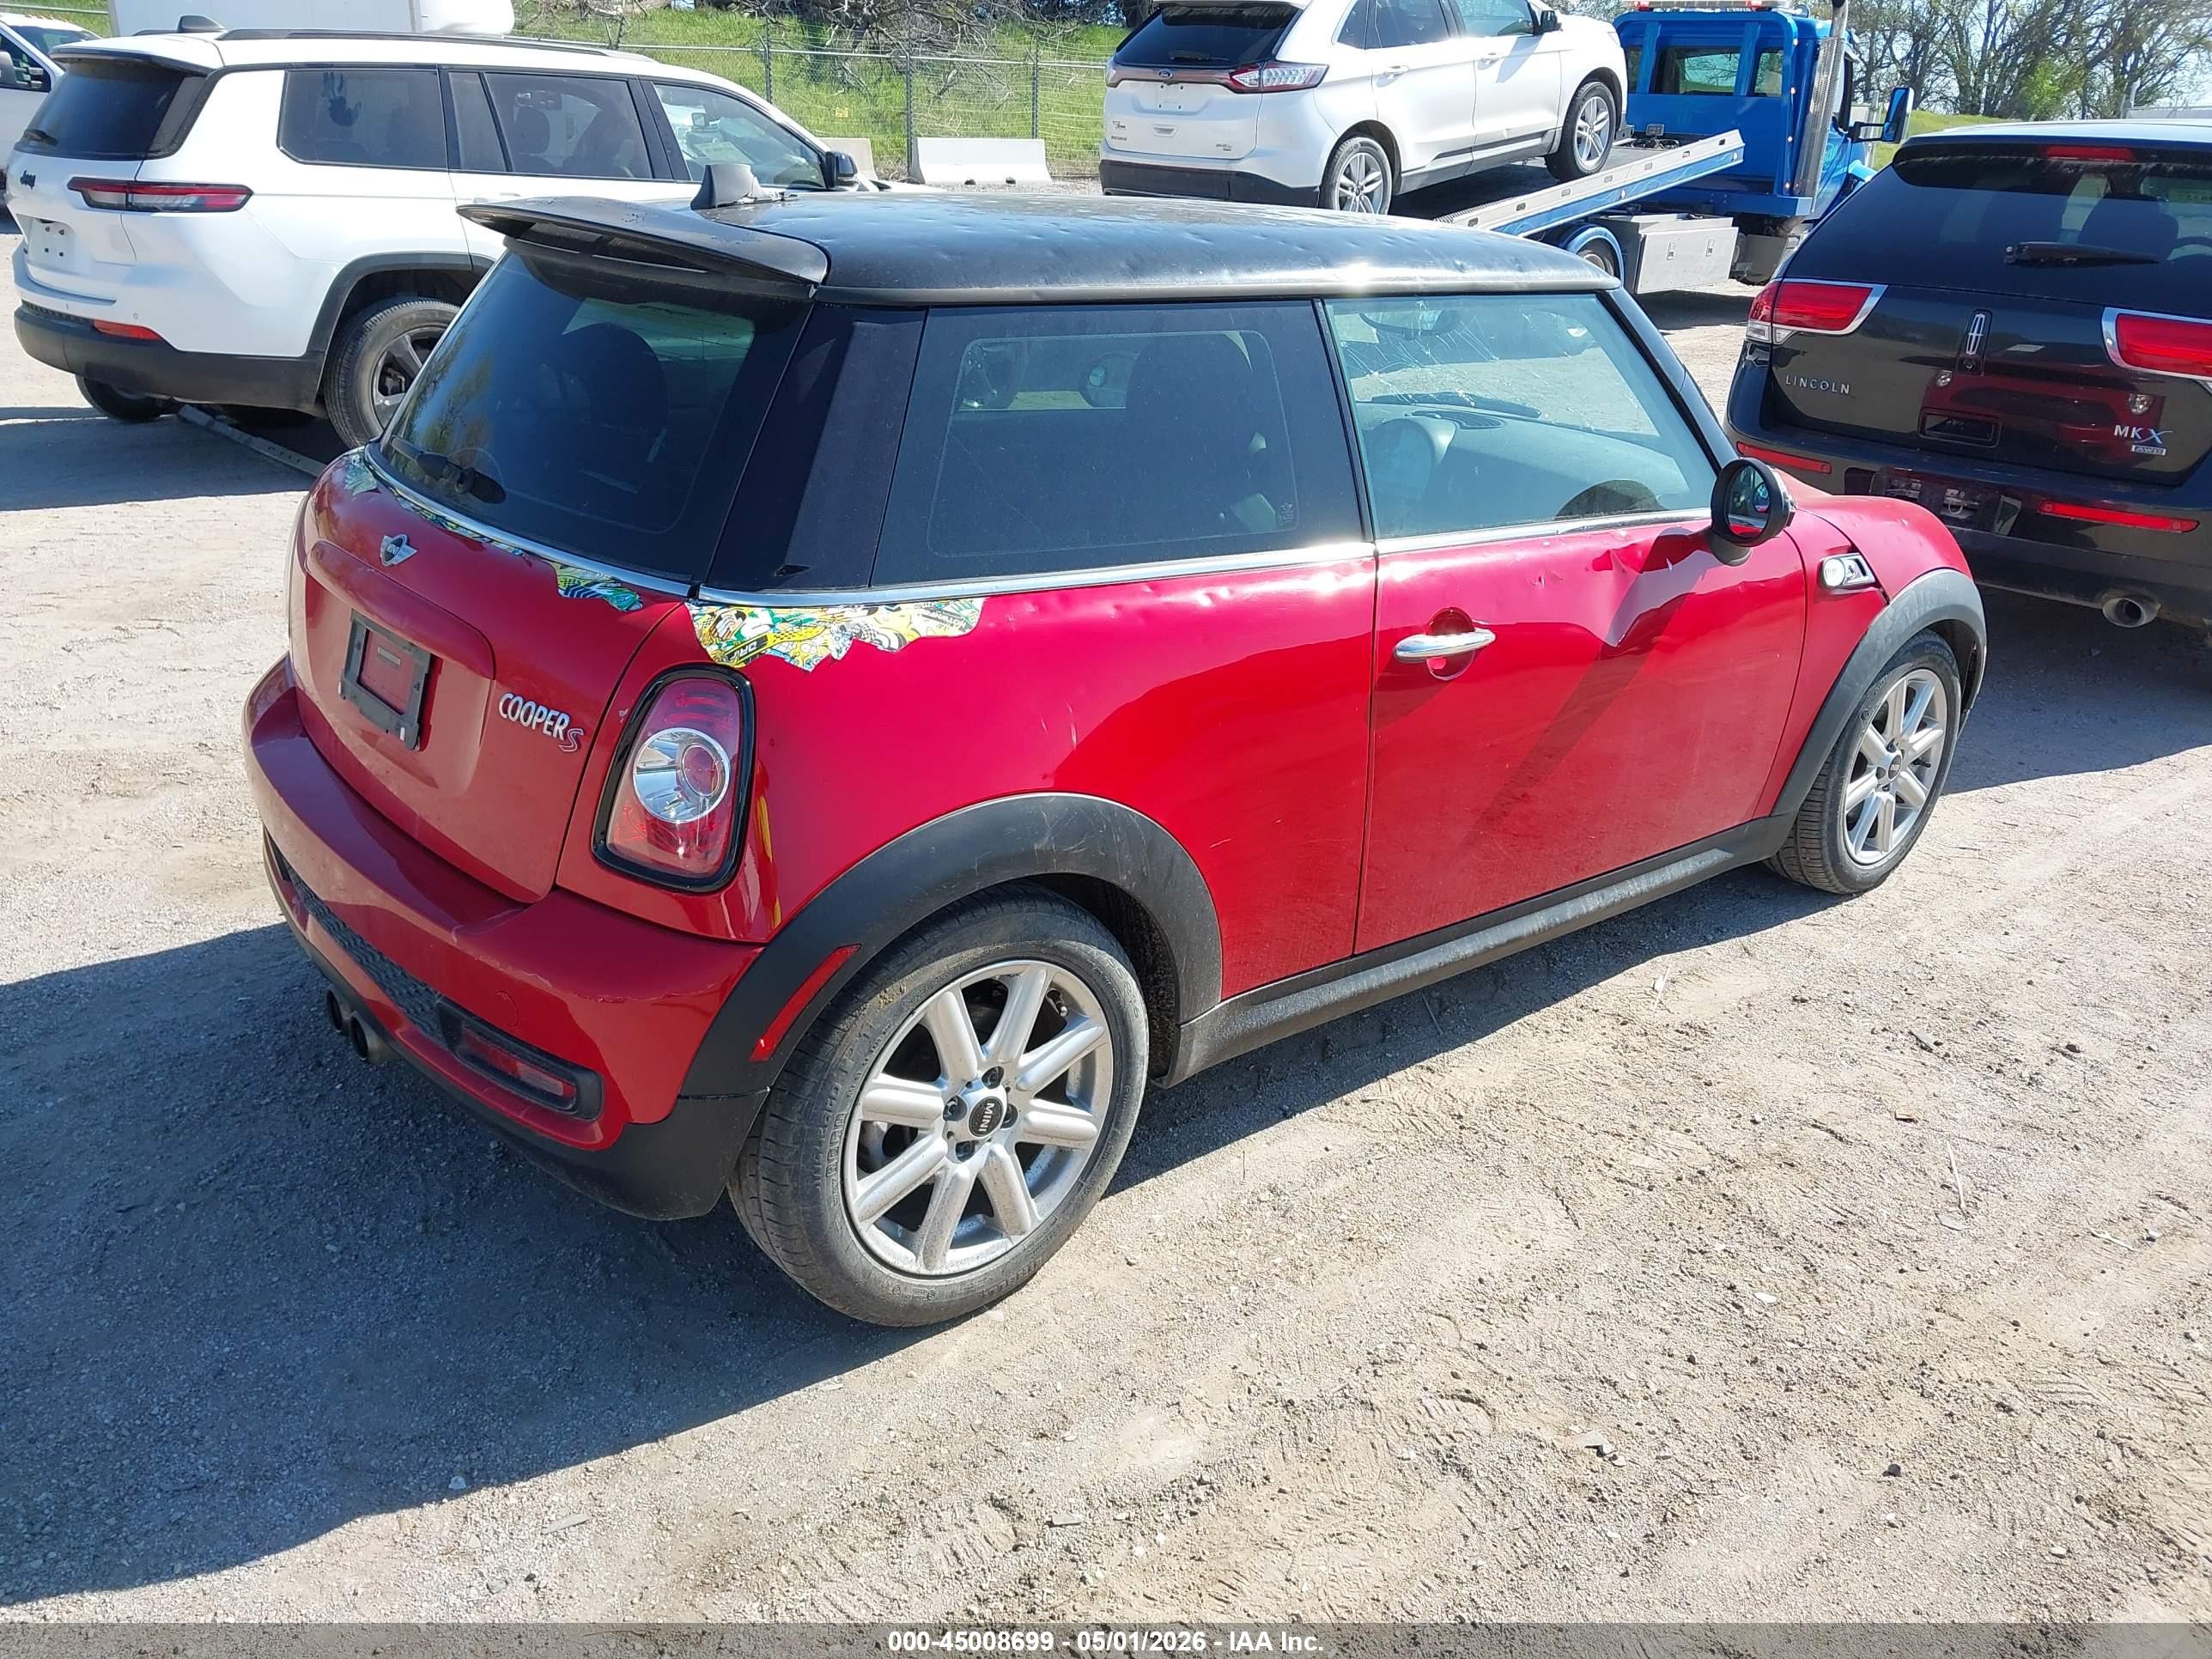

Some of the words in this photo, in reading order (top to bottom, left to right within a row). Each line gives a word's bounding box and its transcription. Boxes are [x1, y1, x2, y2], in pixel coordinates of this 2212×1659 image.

[1785, 374, 1850, 395] LINCOLN
[2113, 424, 2173, 445] MKX
[499, 693, 570, 741] COOPER
[558, 727, 585, 753] S
[978, 1103, 995, 1132] MINI
